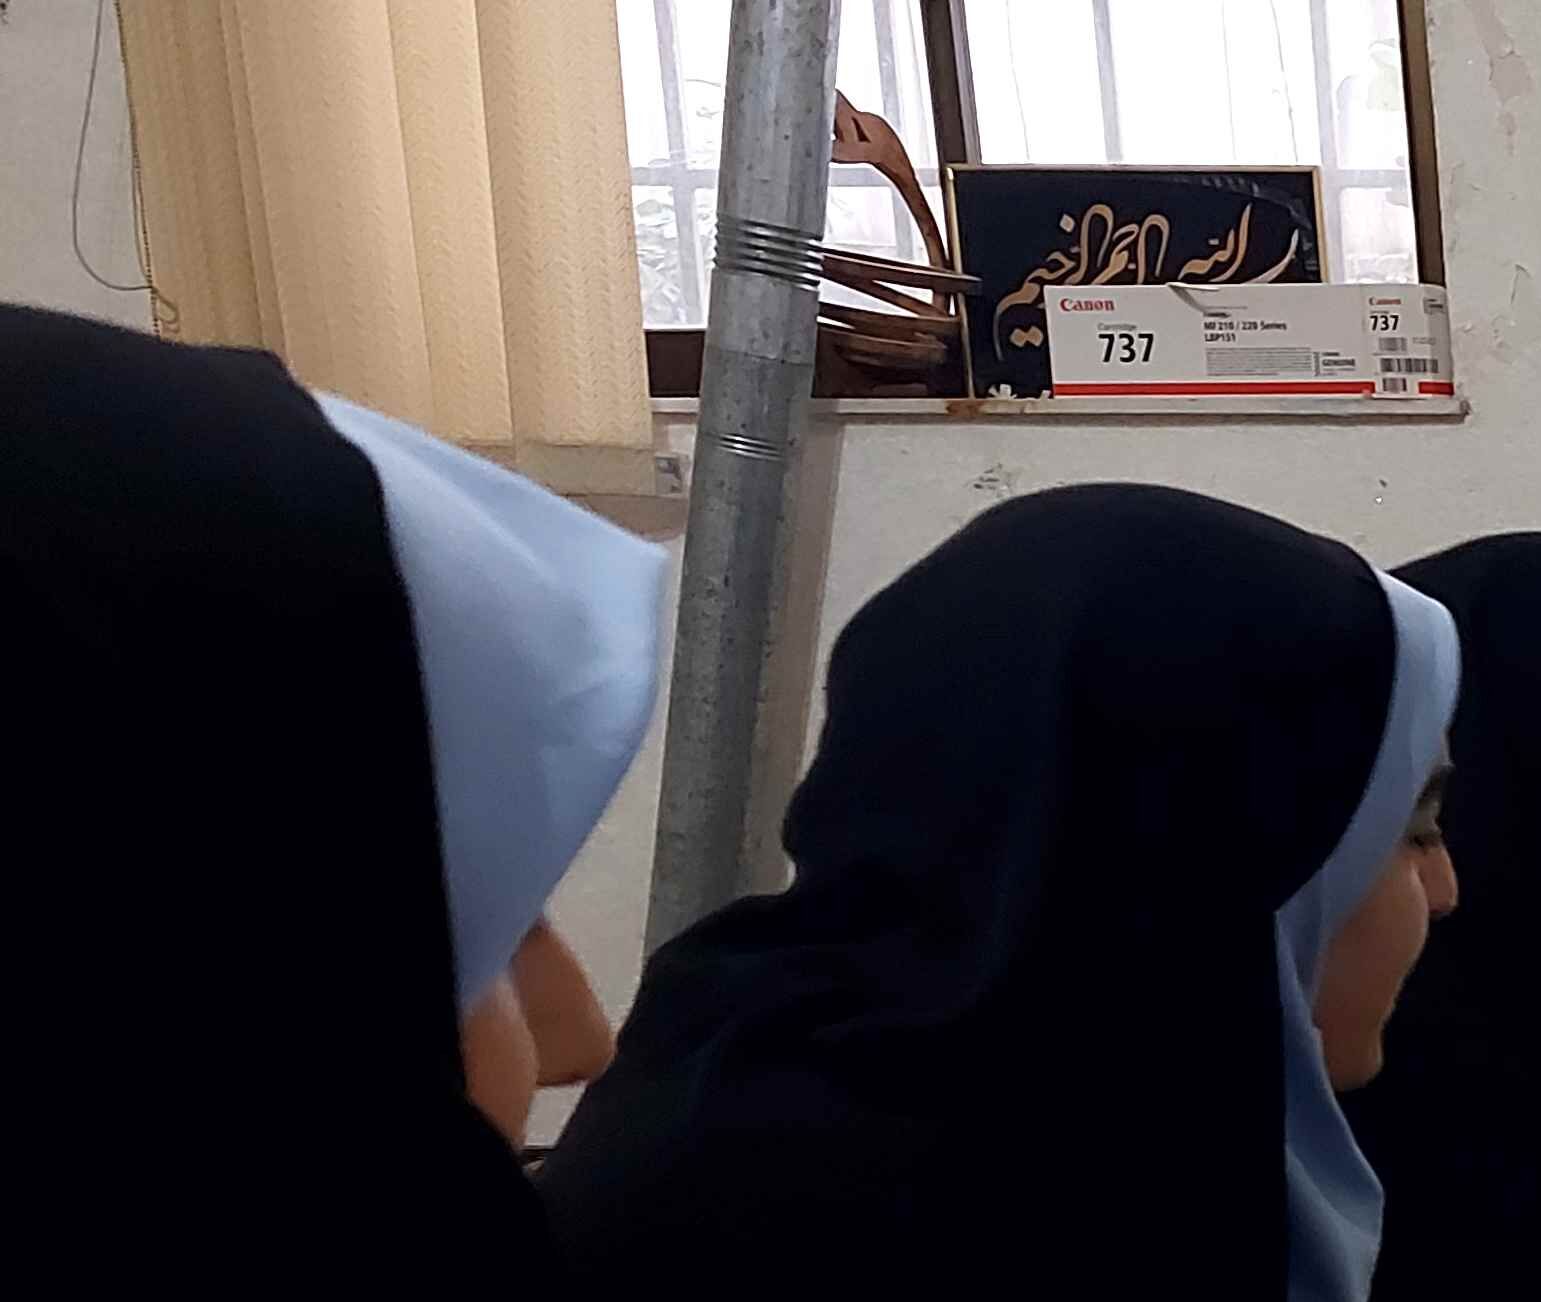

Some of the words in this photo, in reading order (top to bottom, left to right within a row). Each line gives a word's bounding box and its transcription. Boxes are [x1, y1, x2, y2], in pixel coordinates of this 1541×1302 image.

[1060, 298, 1115, 312] Canon
[1369, 315, 1399, 331] 737
[1098, 333, 1154, 363] 737
